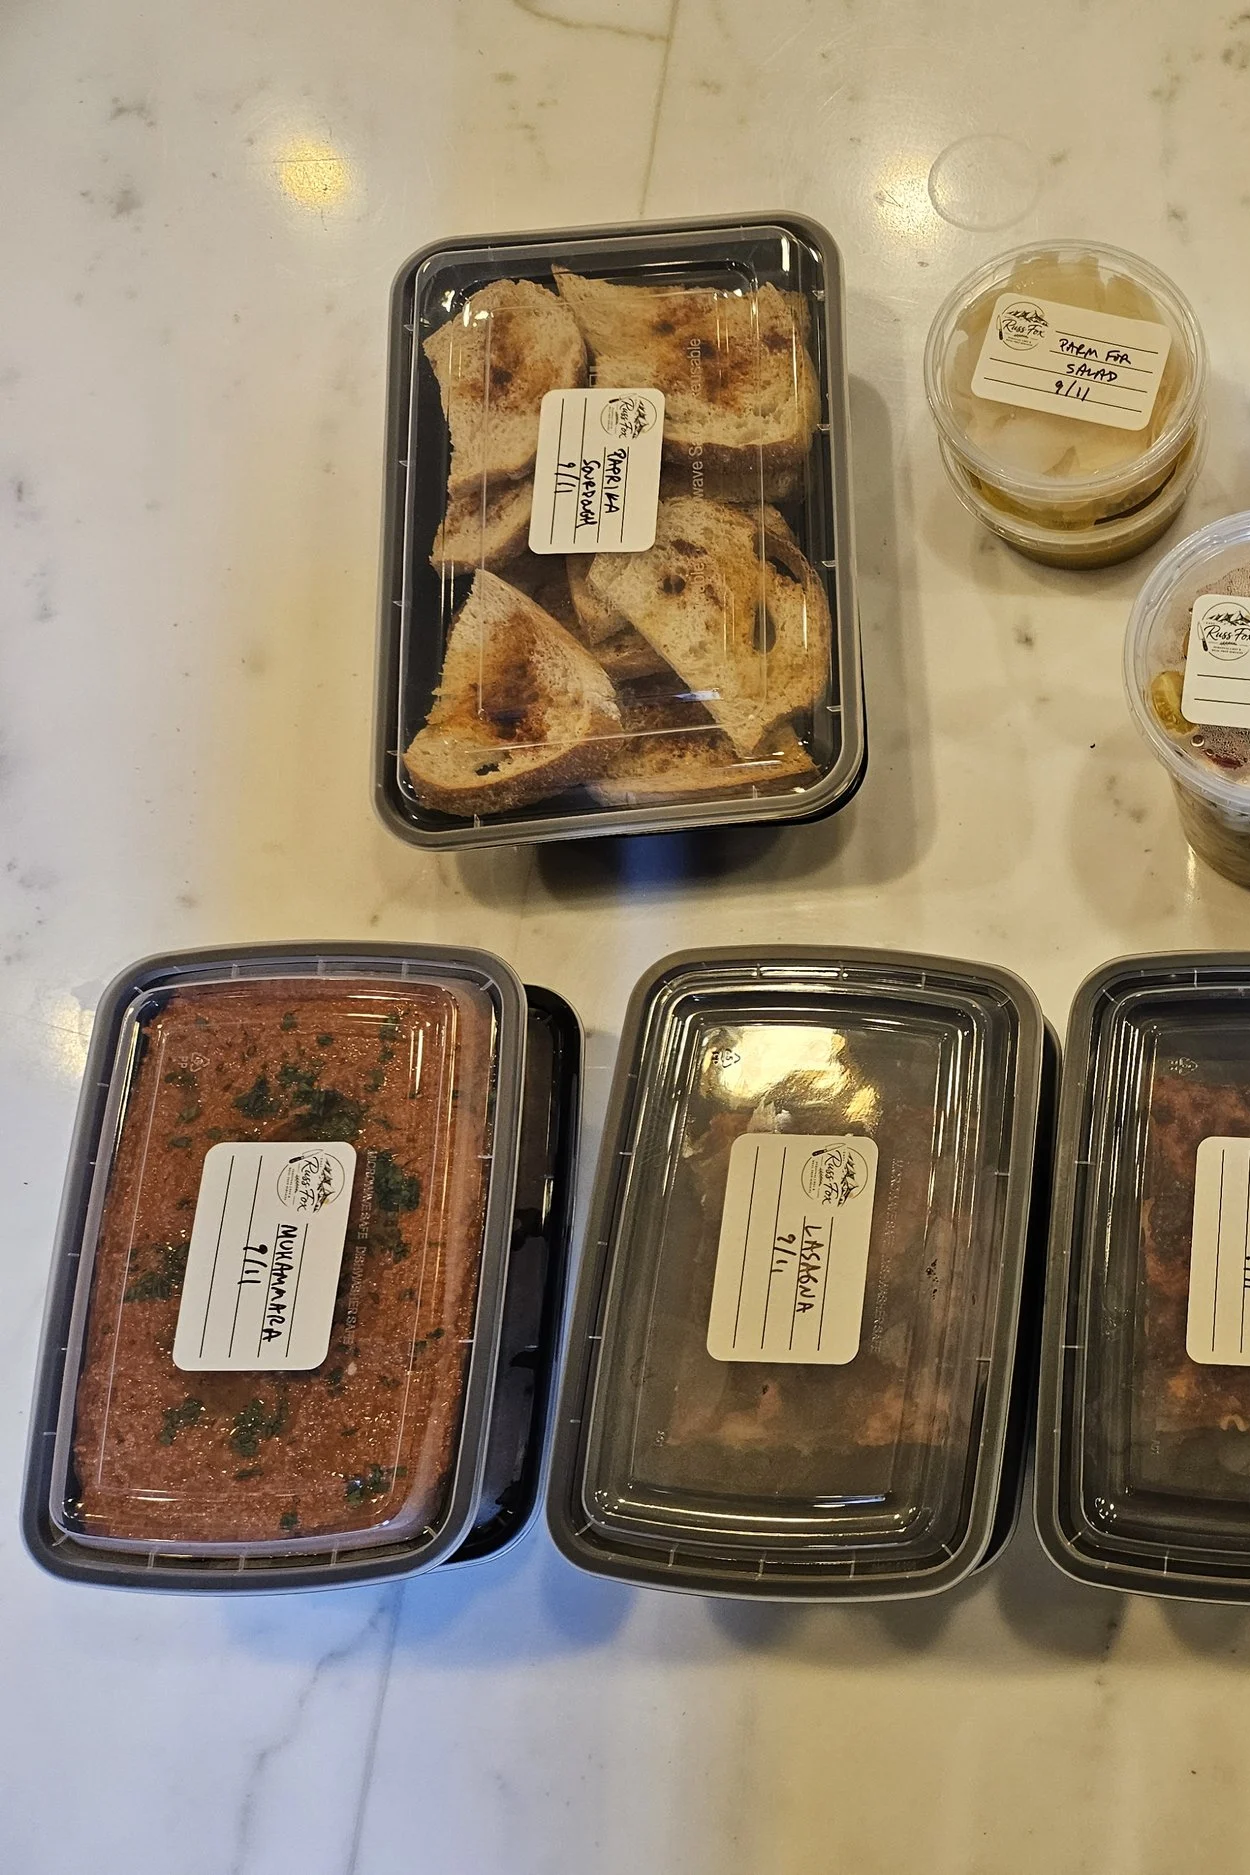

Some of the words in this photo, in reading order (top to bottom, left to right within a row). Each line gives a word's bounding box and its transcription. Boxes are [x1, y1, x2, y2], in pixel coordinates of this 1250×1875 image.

[1001, 318, 1027, 334] Russ
[1026, 324, 1046, 339] Fox
[1058, 338, 1099, 359] PARM
[1104, 349, 1132, 366] FOR
[1065, 363, 1118, 383] SALAD
[1054, 380, 1091, 402] 9/11
[619, 398, 635, 423] Russ
[618, 422, 634, 439] Fox
[554, 461, 581, 494] 9/11
[1203, 623, 1232, 641] Russ
[300, 1155, 321, 1187] Russ
[824, 1149, 843, 1182] Russ
[296, 1187, 316, 1212] Fox
[821, 1181, 840, 1206] Fox
[236, 1243, 269, 1286] 9/11
[795, 1224, 825, 1314] LASAGNA
[261, 1223, 299, 1343] MUHAMMARA
